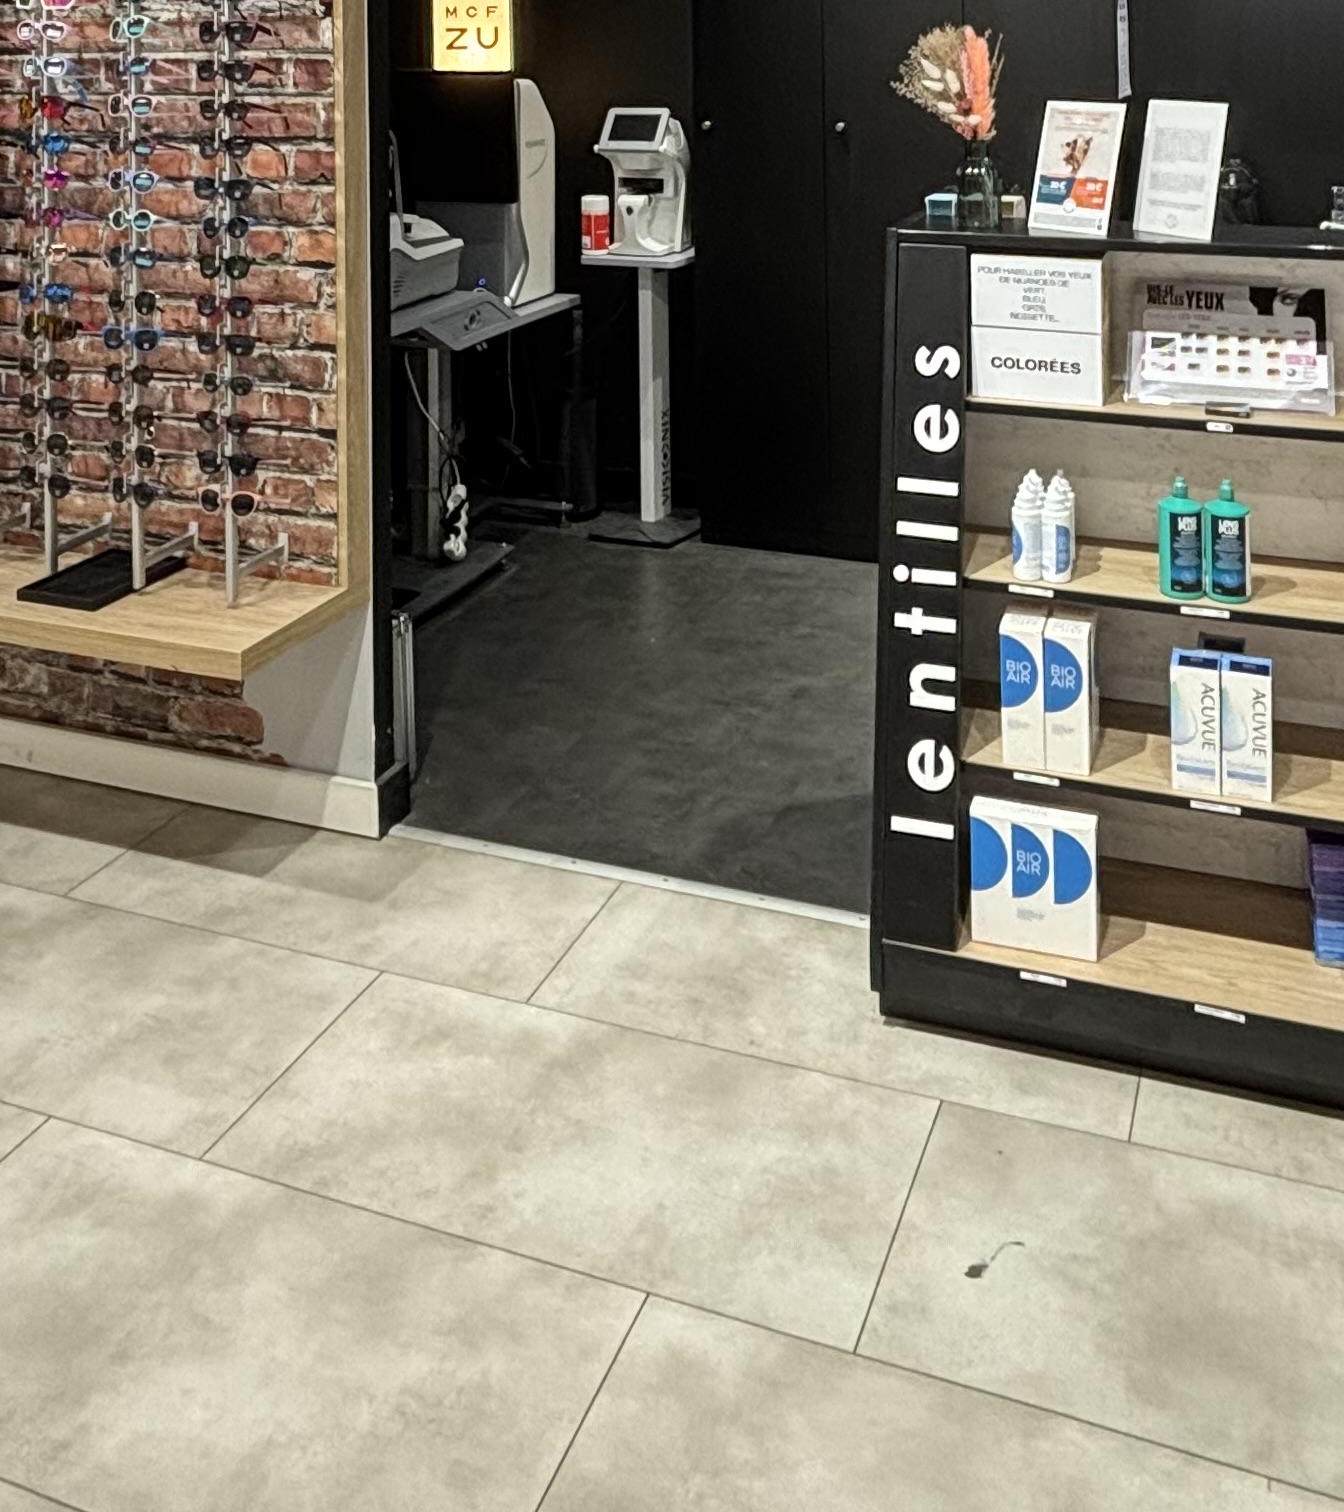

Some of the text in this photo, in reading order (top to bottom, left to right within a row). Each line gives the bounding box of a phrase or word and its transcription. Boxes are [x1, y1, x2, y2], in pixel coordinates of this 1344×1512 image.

[1185, 289, 1225, 312] YEUX
[991, 356, 1082, 375] COLORÉES
[890, 344, 961, 841] lentilles
[1006, 659, 1032, 673] BIO
[1050, 664, 1077, 678] BIO
[1006, 672, 1031, 684] AIR
[1050, 675, 1076, 690] AIR
[1201, 682, 1216, 751] ACUVUE
[1252, 688, 1268, 758] ACUVUE
[1016, 850, 1042, 865] BIO
[1016, 863, 1042, 876] AIR
